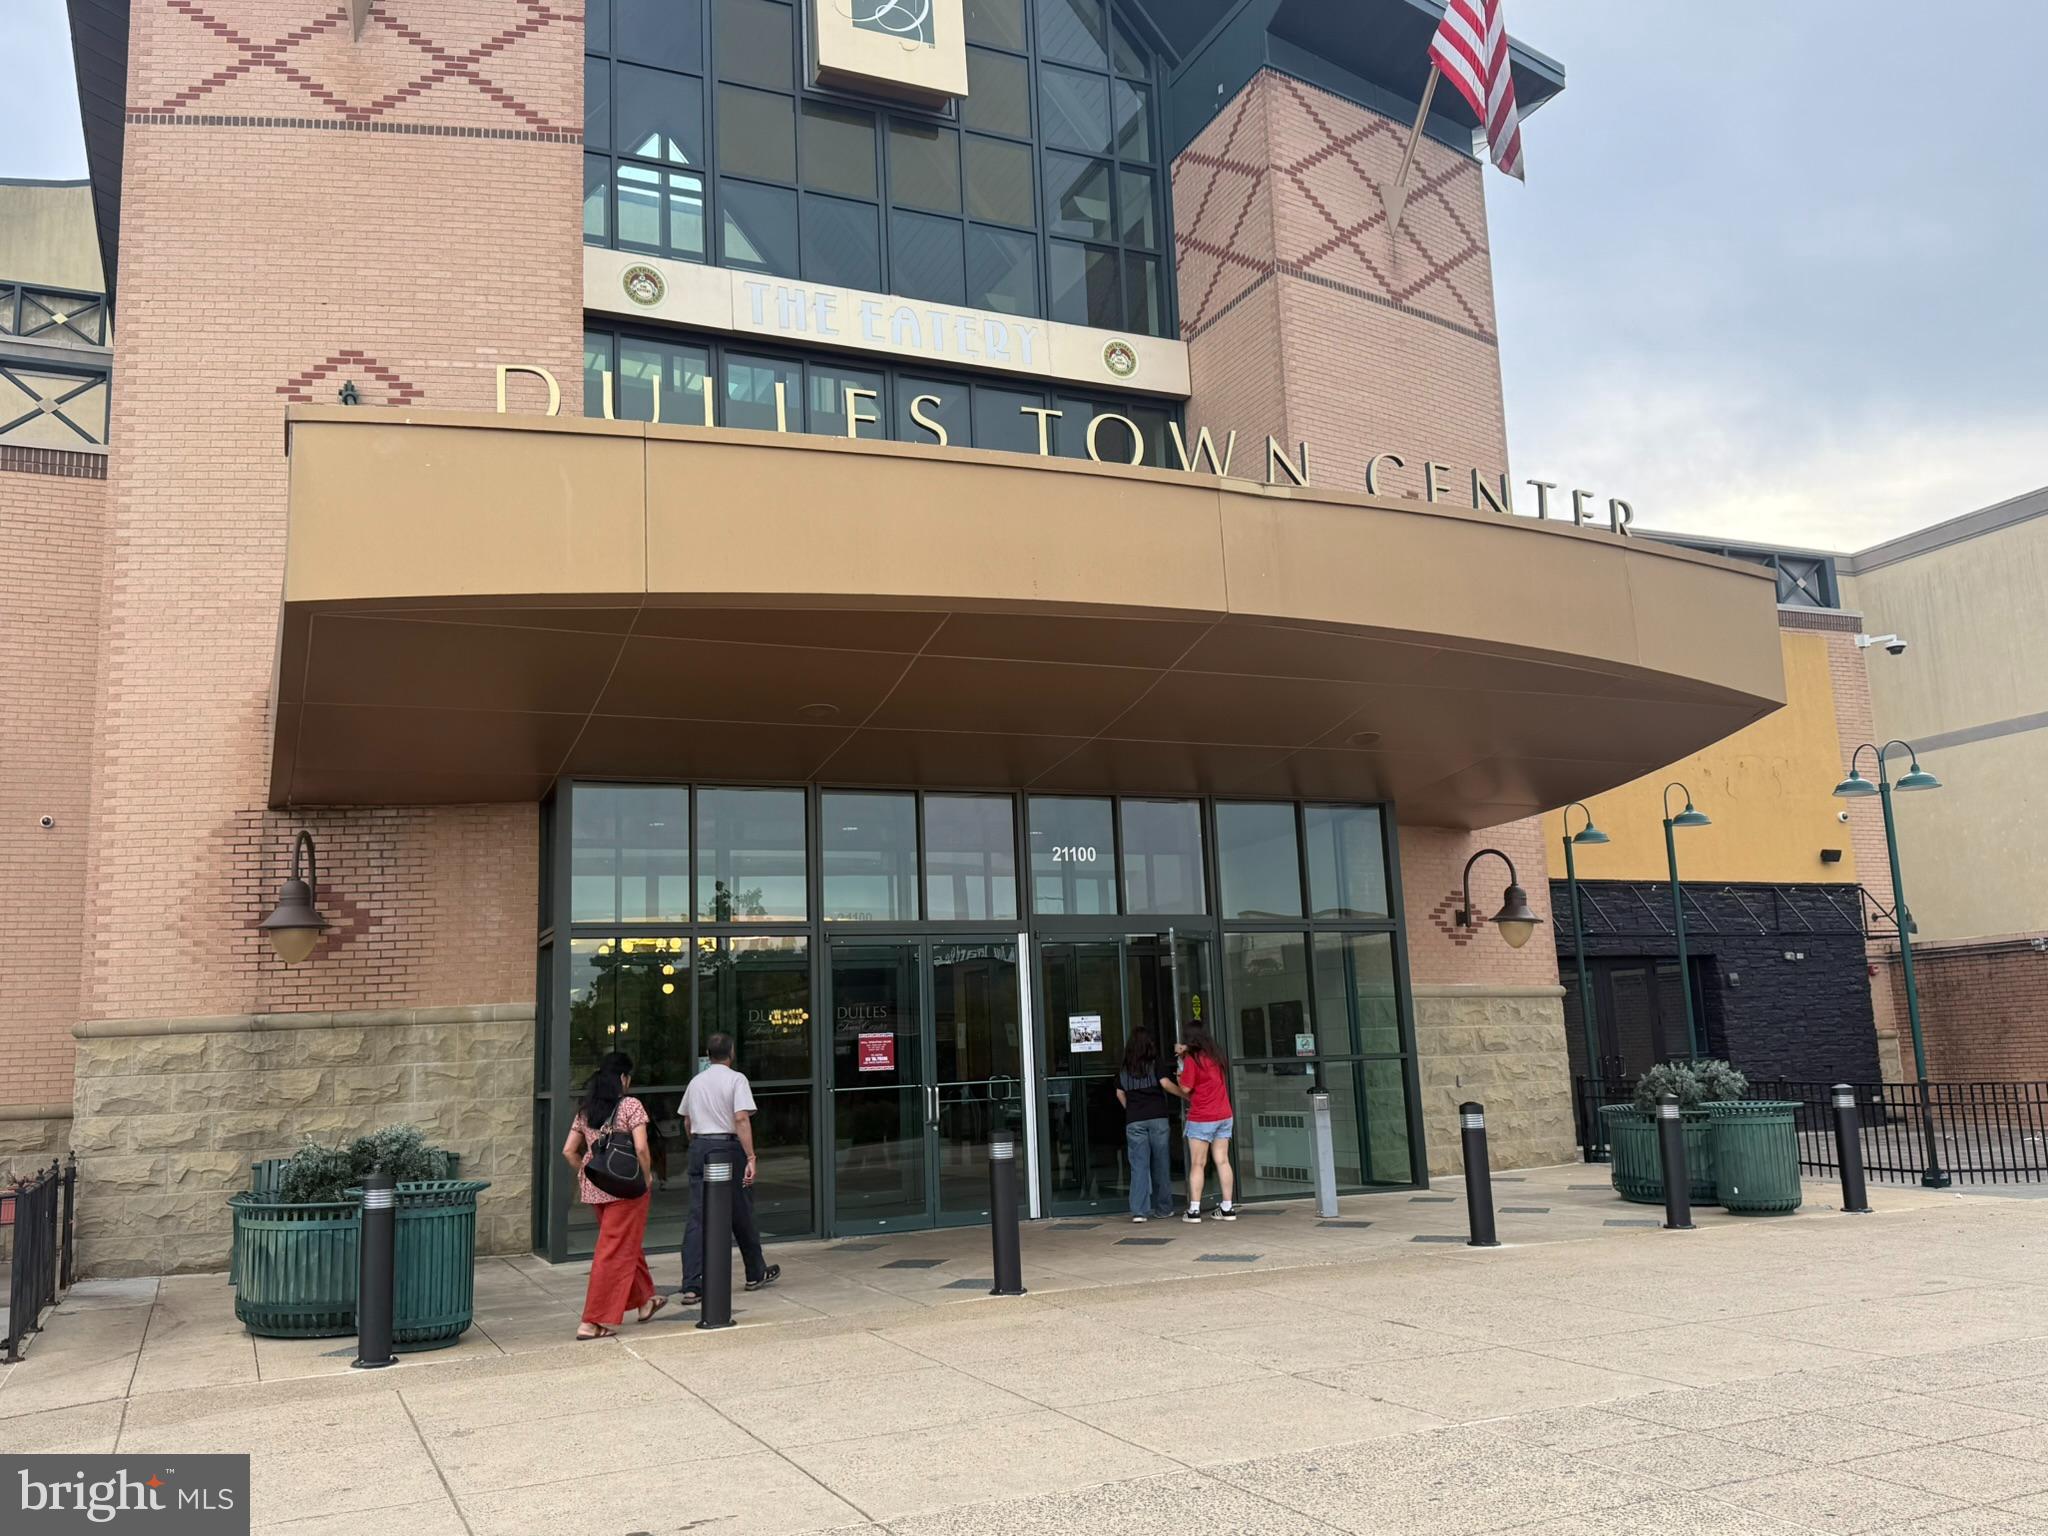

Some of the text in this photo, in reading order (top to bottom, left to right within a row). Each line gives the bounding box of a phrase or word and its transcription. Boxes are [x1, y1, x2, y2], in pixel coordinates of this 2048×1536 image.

[743, 281, 1040, 365] THE EATERY
[1020, 406, 1310, 487] TOWN
[1365, 453, 1635, 537] CENTER
[1052, 846, 1097, 862] 21100
[837, 1005, 887, 1021] DULLES
